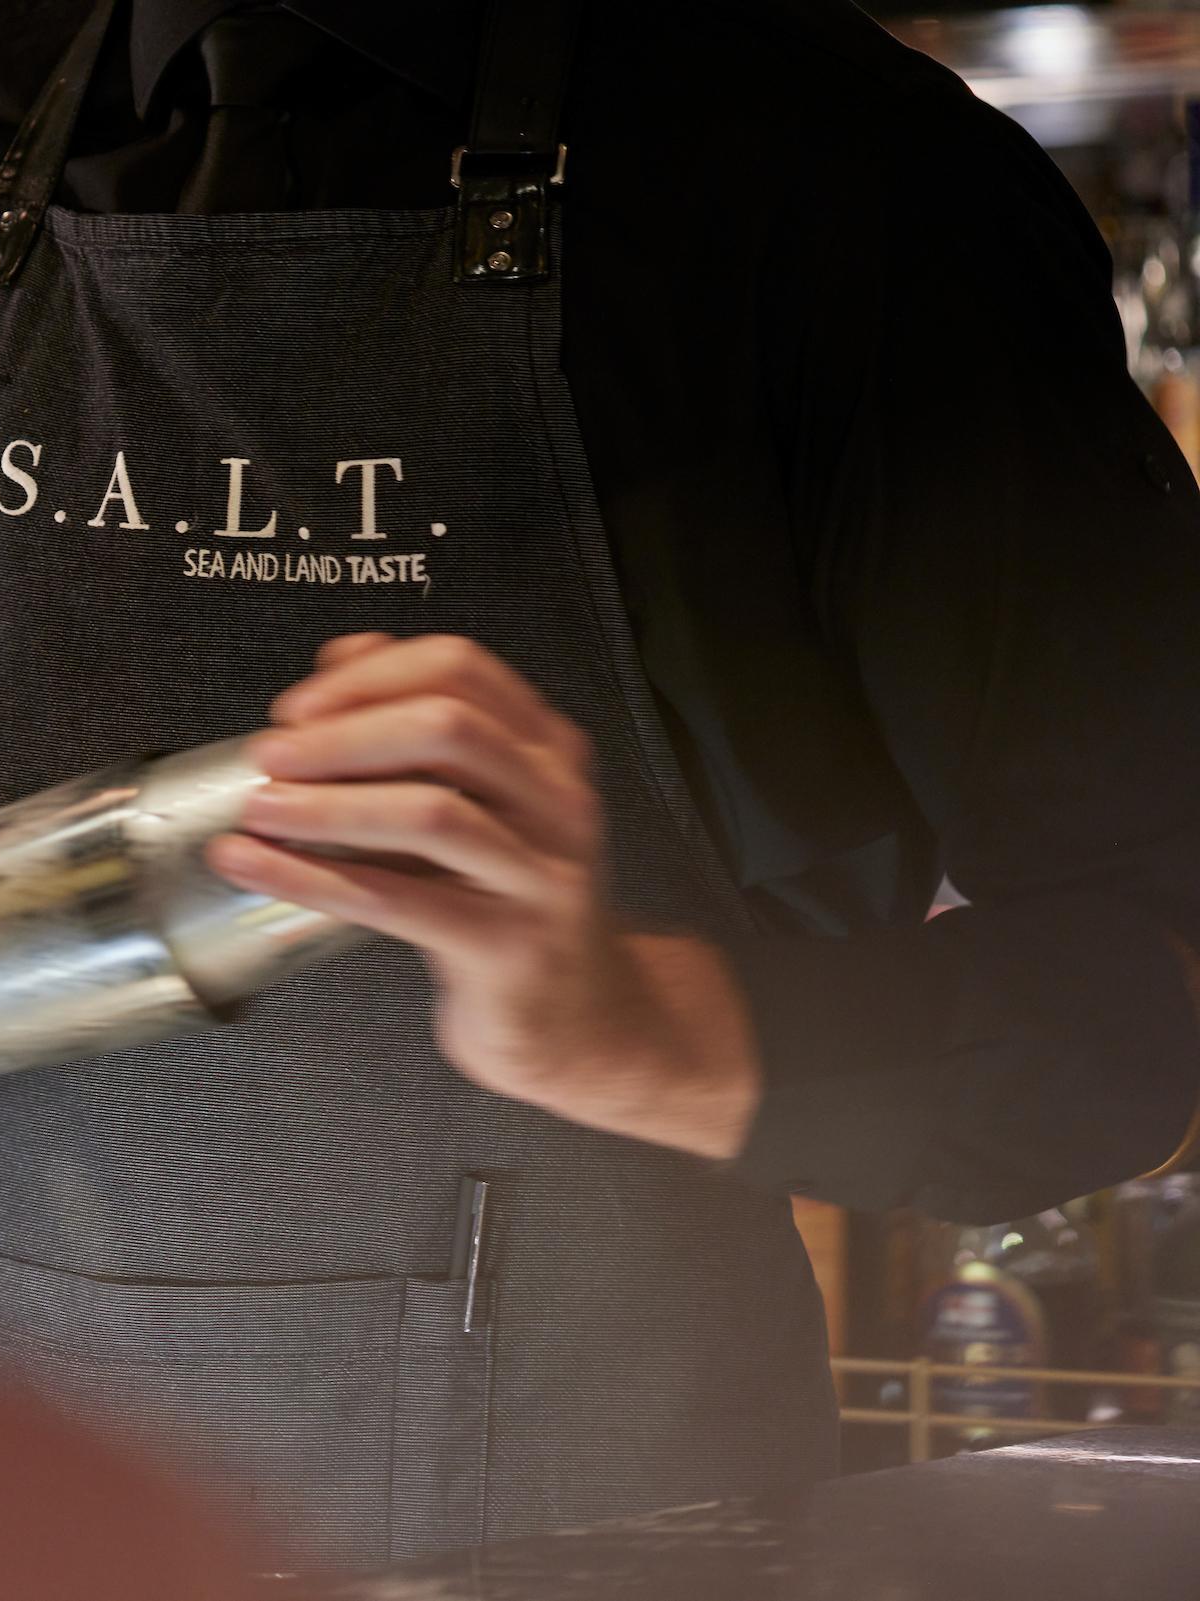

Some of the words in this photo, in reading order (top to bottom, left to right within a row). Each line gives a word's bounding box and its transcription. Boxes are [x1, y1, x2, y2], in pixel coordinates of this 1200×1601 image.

[183, 548, 225, 578] SEA
[229, 552, 279, 582] AND
[285, 553, 342, 585] LAND
[344, 554, 427, 584] TASTE
